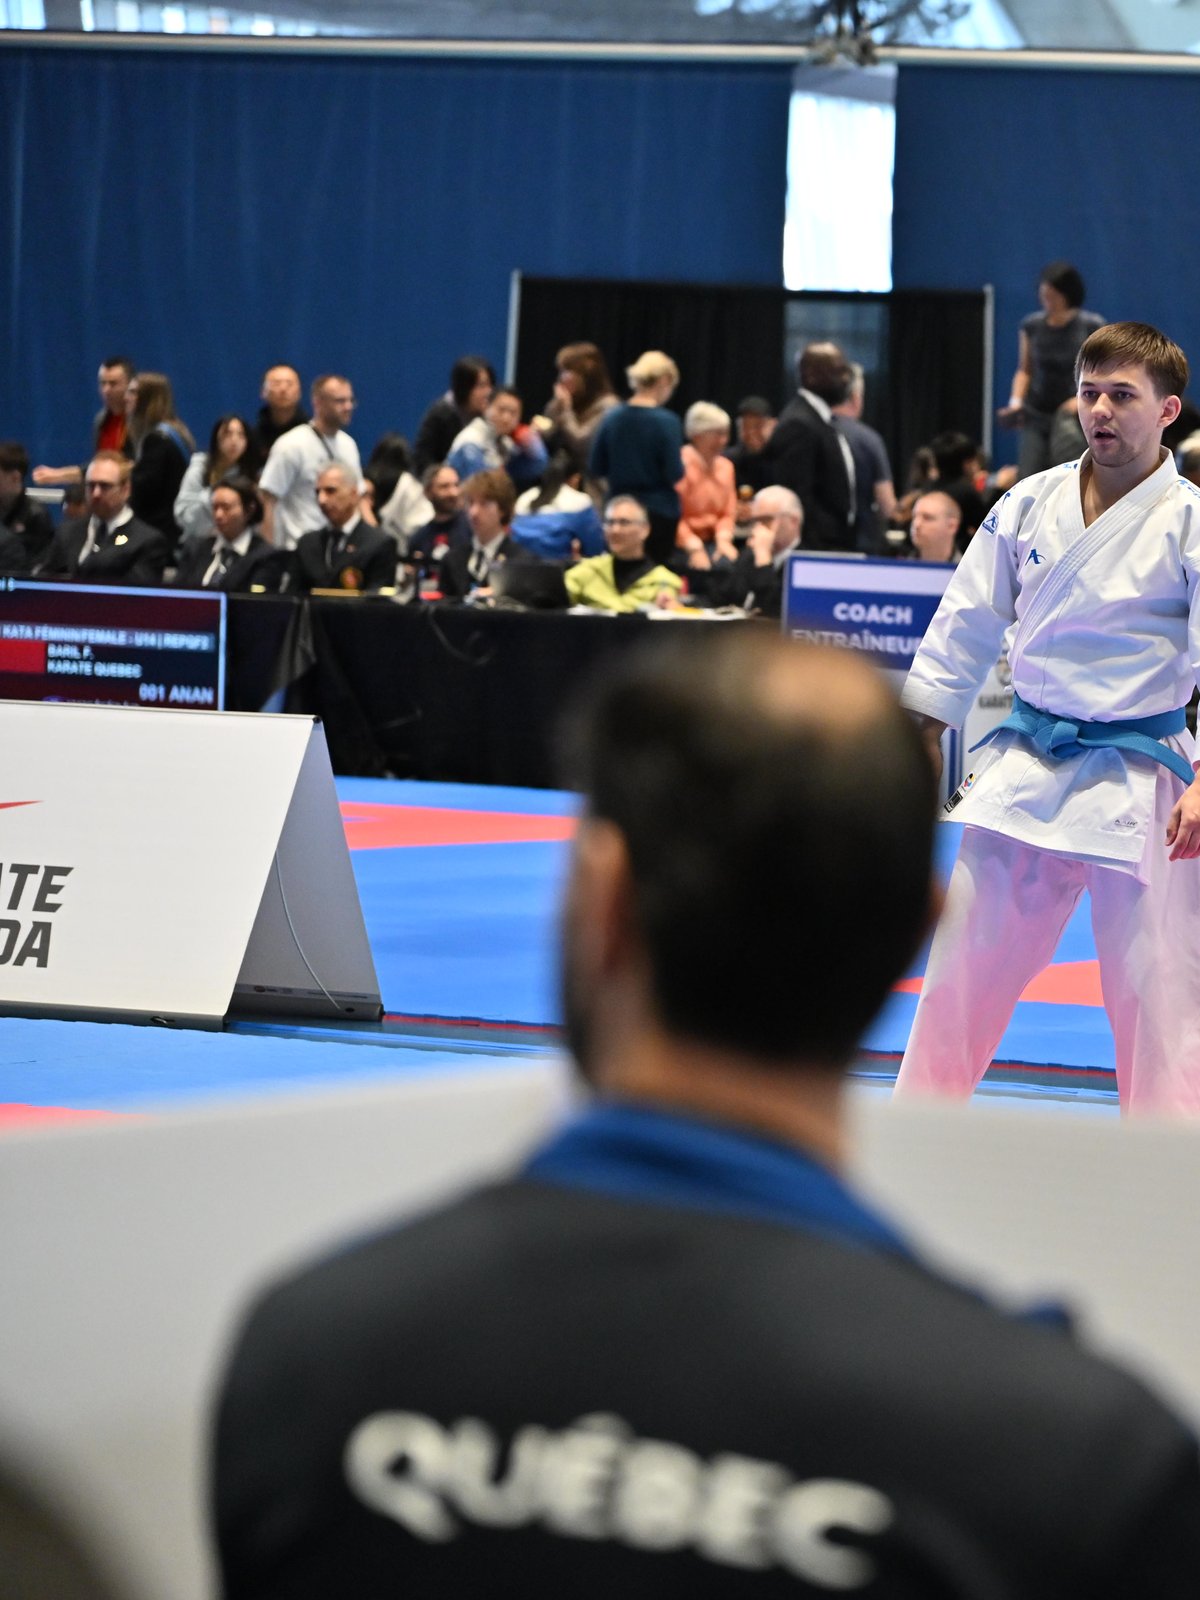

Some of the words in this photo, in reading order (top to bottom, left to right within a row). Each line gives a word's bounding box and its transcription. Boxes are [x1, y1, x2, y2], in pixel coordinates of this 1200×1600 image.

[832, 602, 913, 625] COACH
[2, 624, 33, 640] KATA
[47, 660, 92, 676] KARATE
[139, 682, 165, 702] 001
[168, 684, 214, 704] ANAN
[0, 862, 74, 913] TE
[342, 1408, 894, 1590] QUÉBEC
